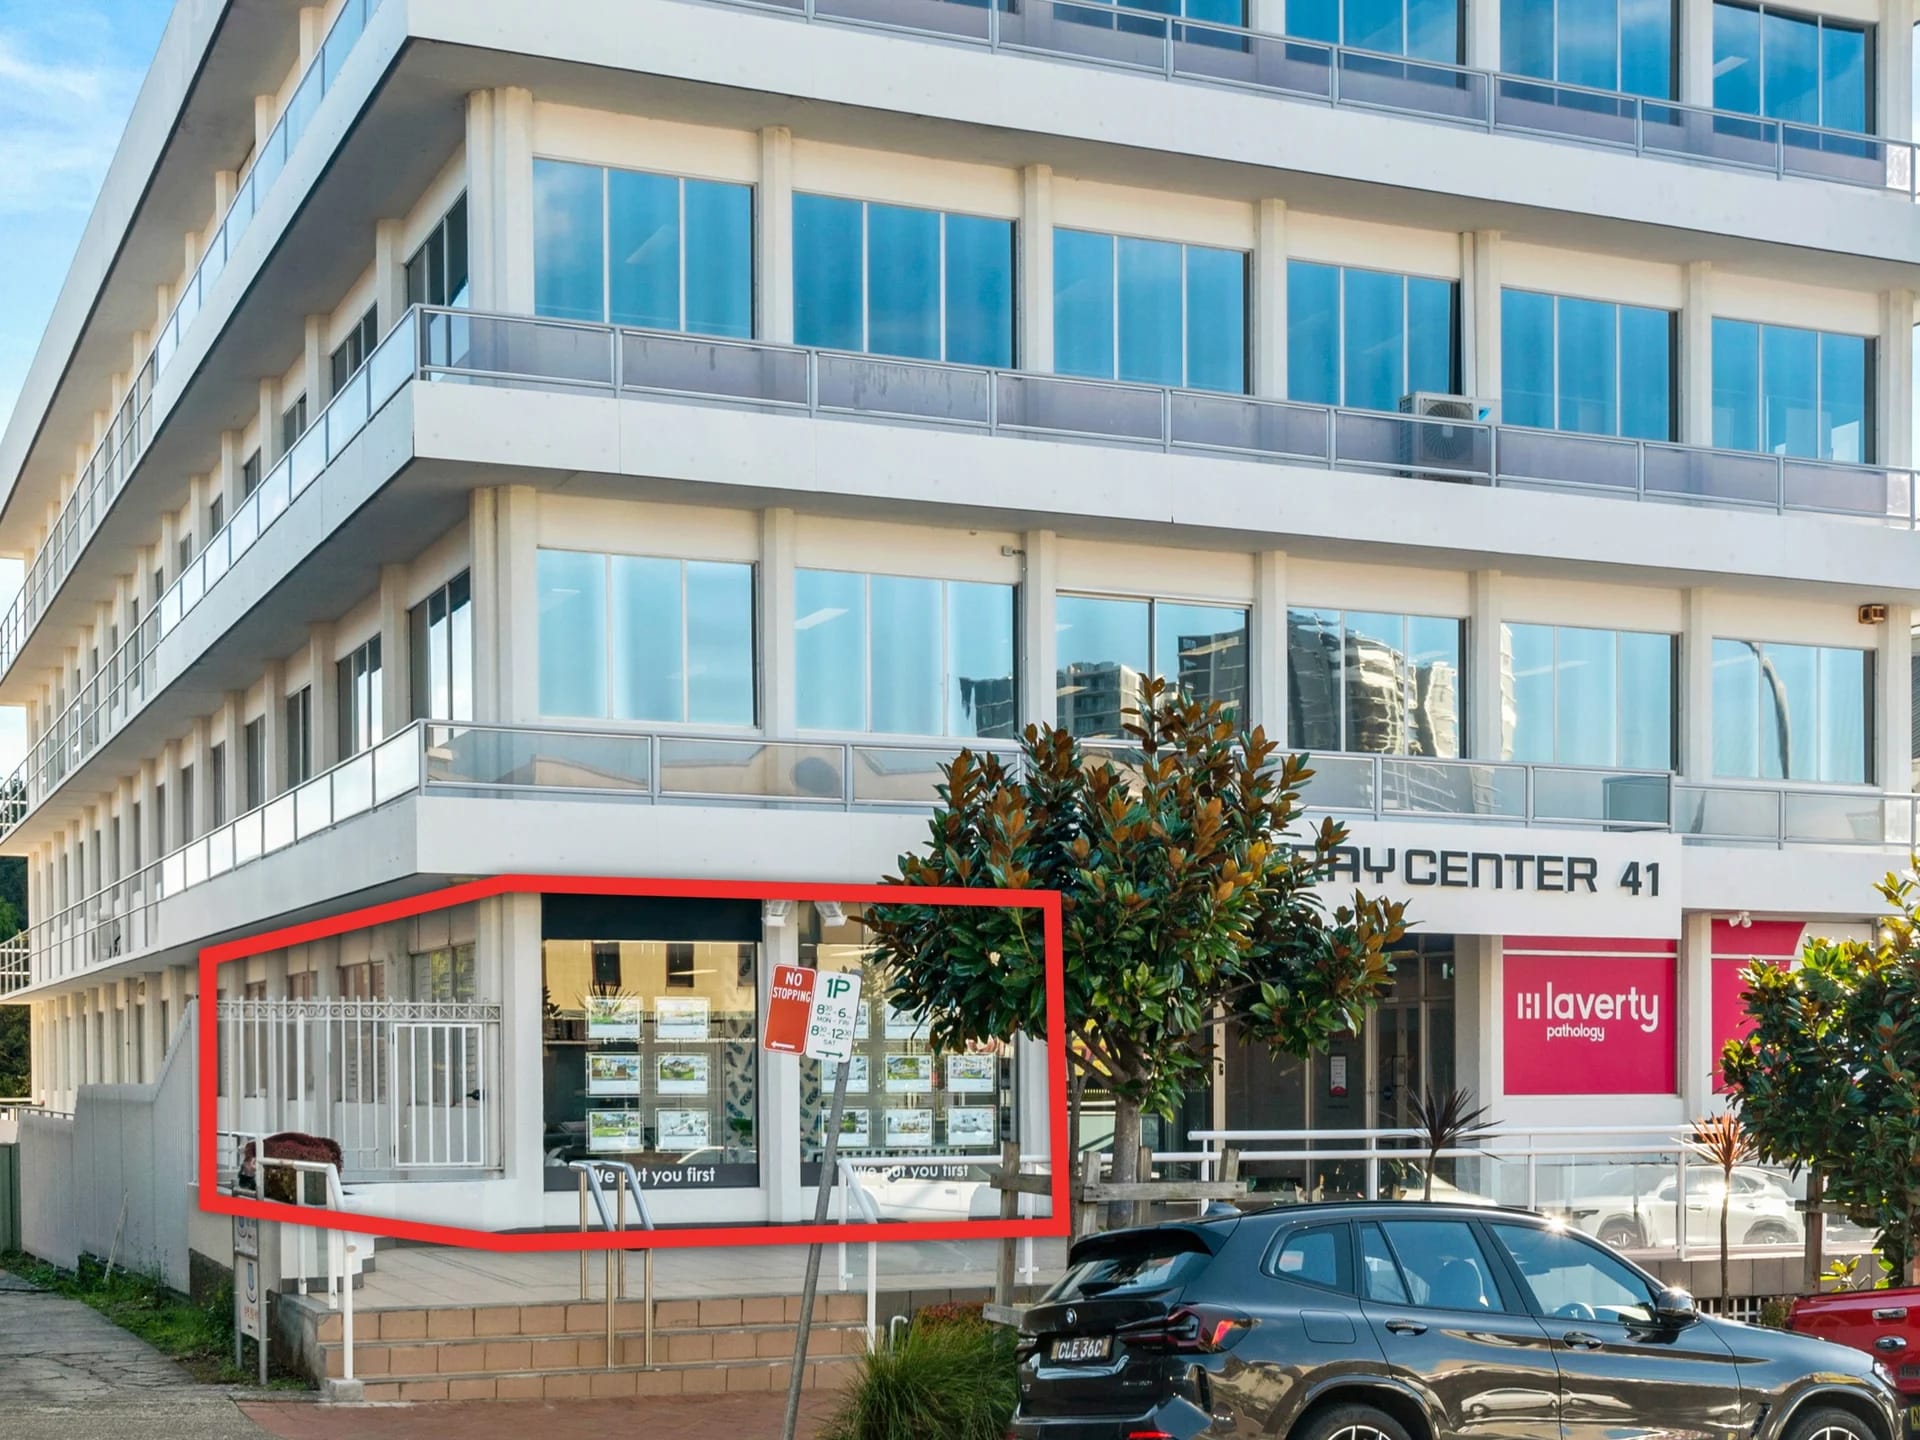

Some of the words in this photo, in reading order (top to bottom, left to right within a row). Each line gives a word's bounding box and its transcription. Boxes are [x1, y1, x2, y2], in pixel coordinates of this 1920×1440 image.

[1405, 849, 1598, 893] CENTER
[1620, 861, 1660, 897] 41
[785, 972, 803, 986] NO
[827, 978, 851, 999] 1P
[772, 987, 811, 1002] STOPPING
[1547, 982, 1659, 1033] laverty
[1547, 1024, 1605, 1043] pathology
[652, 1170, 682, 1186] you
[687, 1166, 715, 1182] first
[910, 1165, 938, 1179] you
[942, 1164, 969, 1177] first
[1058, 1341, 1079, 1359] CLE
